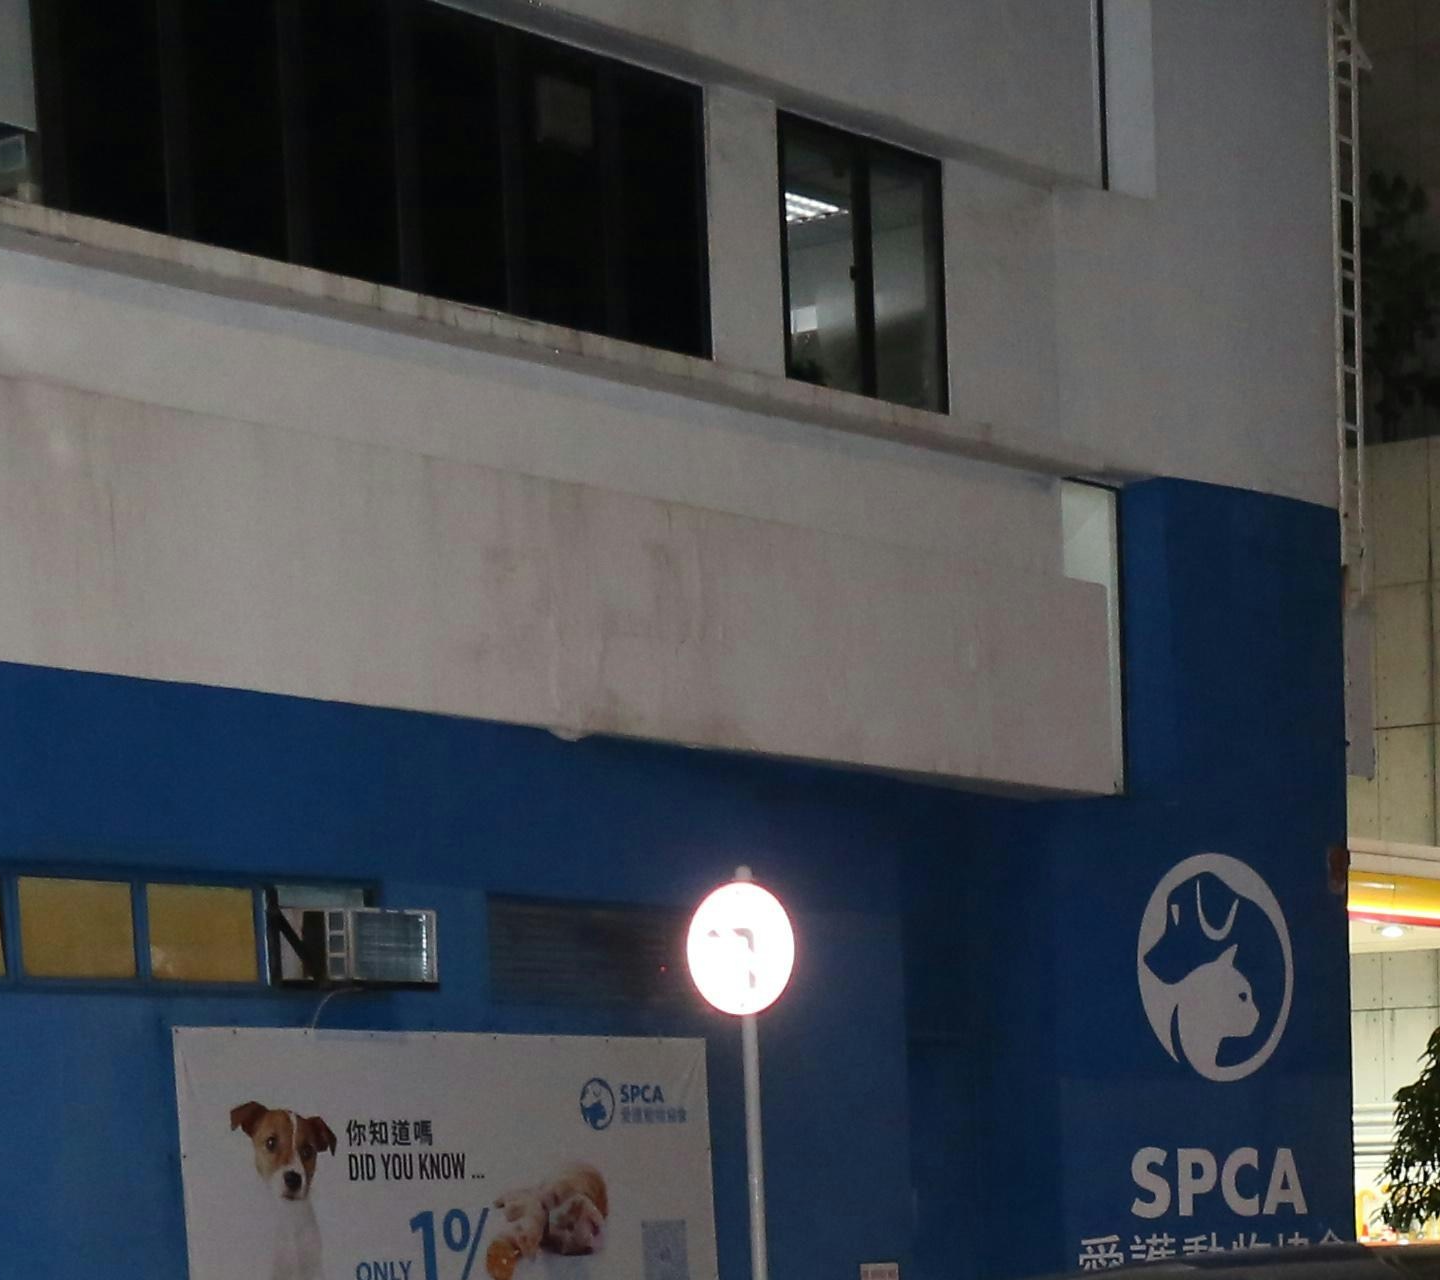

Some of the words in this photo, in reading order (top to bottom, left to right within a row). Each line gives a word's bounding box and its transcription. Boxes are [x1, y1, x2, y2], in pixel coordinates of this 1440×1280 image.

[620, 1084, 664, 1103] SPCA
[346, 1119, 433, 1147] 你知道嗎
[348, 1153, 376, 1181] DID
[381, 1153, 413, 1181] YOU
[419, 1152, 465, 1180] KNOW
[1130, 1146, 1309, 1219] SPCA
